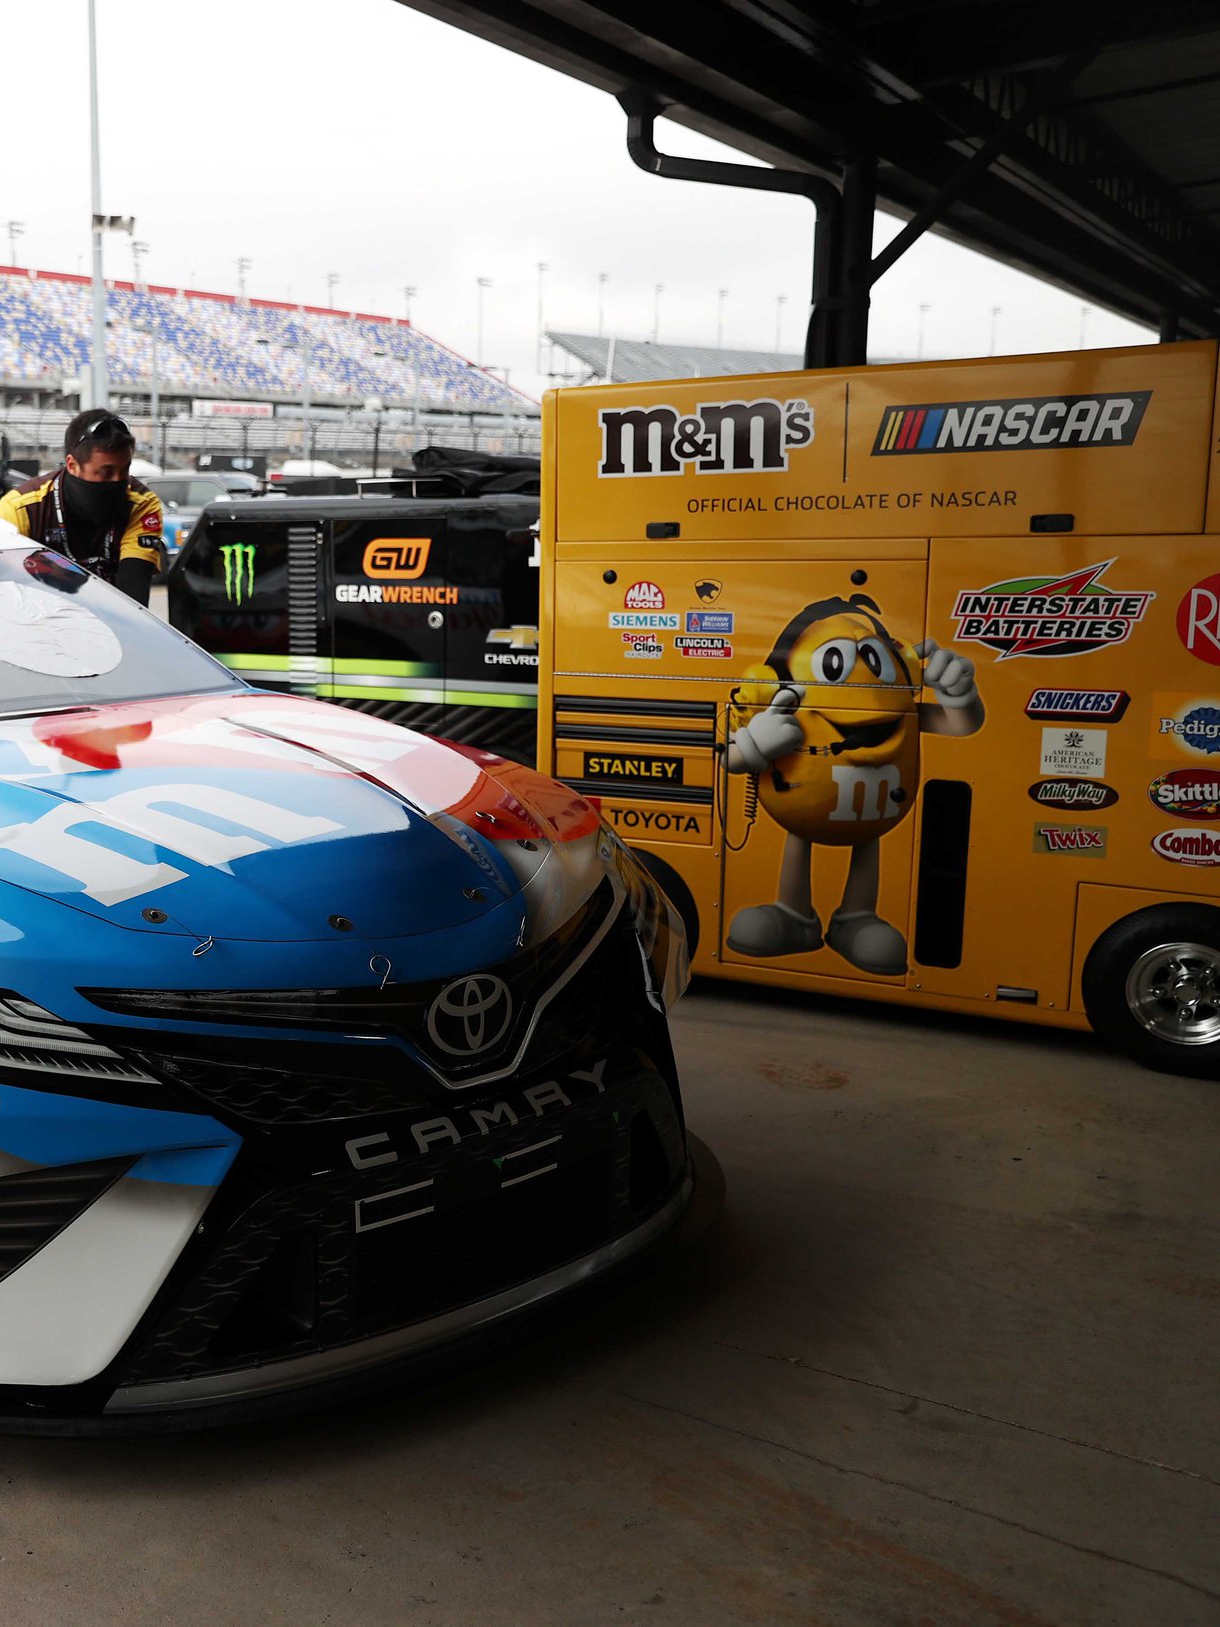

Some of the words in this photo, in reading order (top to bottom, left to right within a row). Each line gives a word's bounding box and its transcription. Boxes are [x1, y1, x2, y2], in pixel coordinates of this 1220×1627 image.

[936, 399, 1134, 448] NASCAR
[687, 496, 768, 513] OFFICIAL
[774, 492, 890, 512] CHOCOLATE
[897, 492, 924, 509] OF
[930, 490, 1017, 508] NASCAR
[335, 584, 459, 605] GEARWRENCH
[626, 583, 662, 601] MAC
[956, 597, 1143, 617] INTERSTATE
[612, 614, 677, 627] SIEMENS
[964, 619, 1127, 639] BATTERIES
[1187, 588, 1220, 650] R
[623, 633, 656, 644] Sport
[634, 642, 663, 653] Clips
[677, 638, 722, 648] LINCOLN
[484, 654, 539, 666] CHEVRO
[1031, 691, 1117, 712] SNICKERS
[1159, 718, 1220, 739] Pedig
[1044, 755, 1102, 766] HERITAGE
[1052, 749, 1095, 757] AMERICAN
[588, 757, 677, 779] STANLEY
[610, 809, 700, 834] TOYOTA
[1040, 827, 1103, 850] Twix
[345, 1059, 610, 1170] CAMRY
